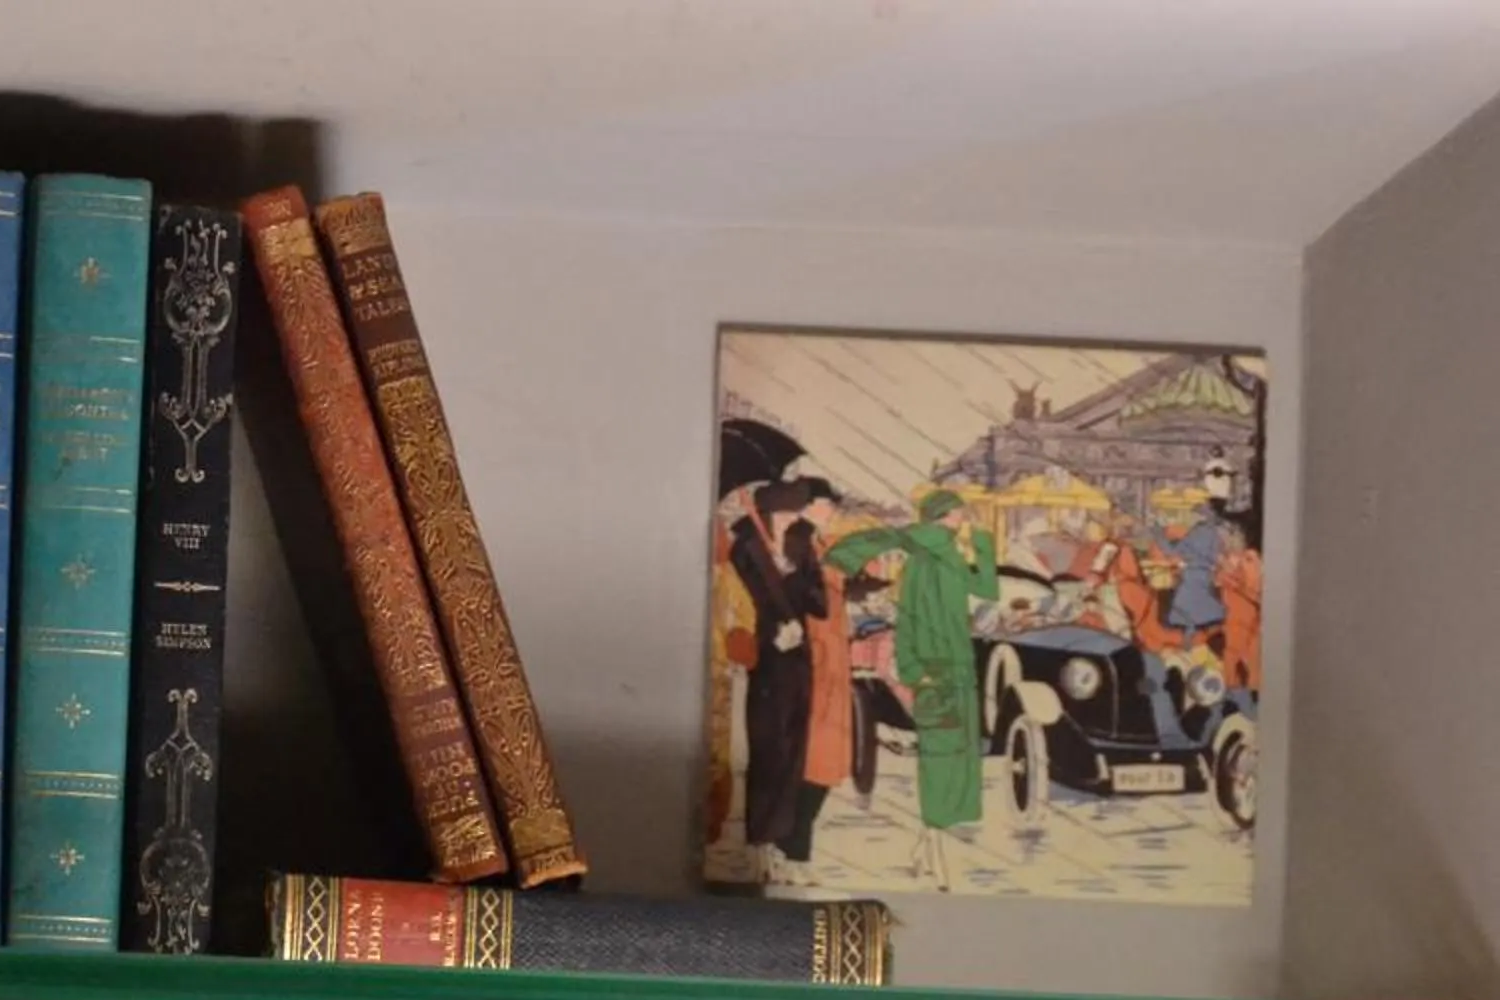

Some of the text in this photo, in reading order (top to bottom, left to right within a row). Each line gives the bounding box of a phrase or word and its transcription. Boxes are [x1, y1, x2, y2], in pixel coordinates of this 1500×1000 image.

[162, 522, 211, 538] HENRY
[174, 537, 201, 549] VIII
[160, 622, 208, 636] HELEN
[344, 890, 361, 959] LORNA
[367, 892, 384, 961] DOONE
